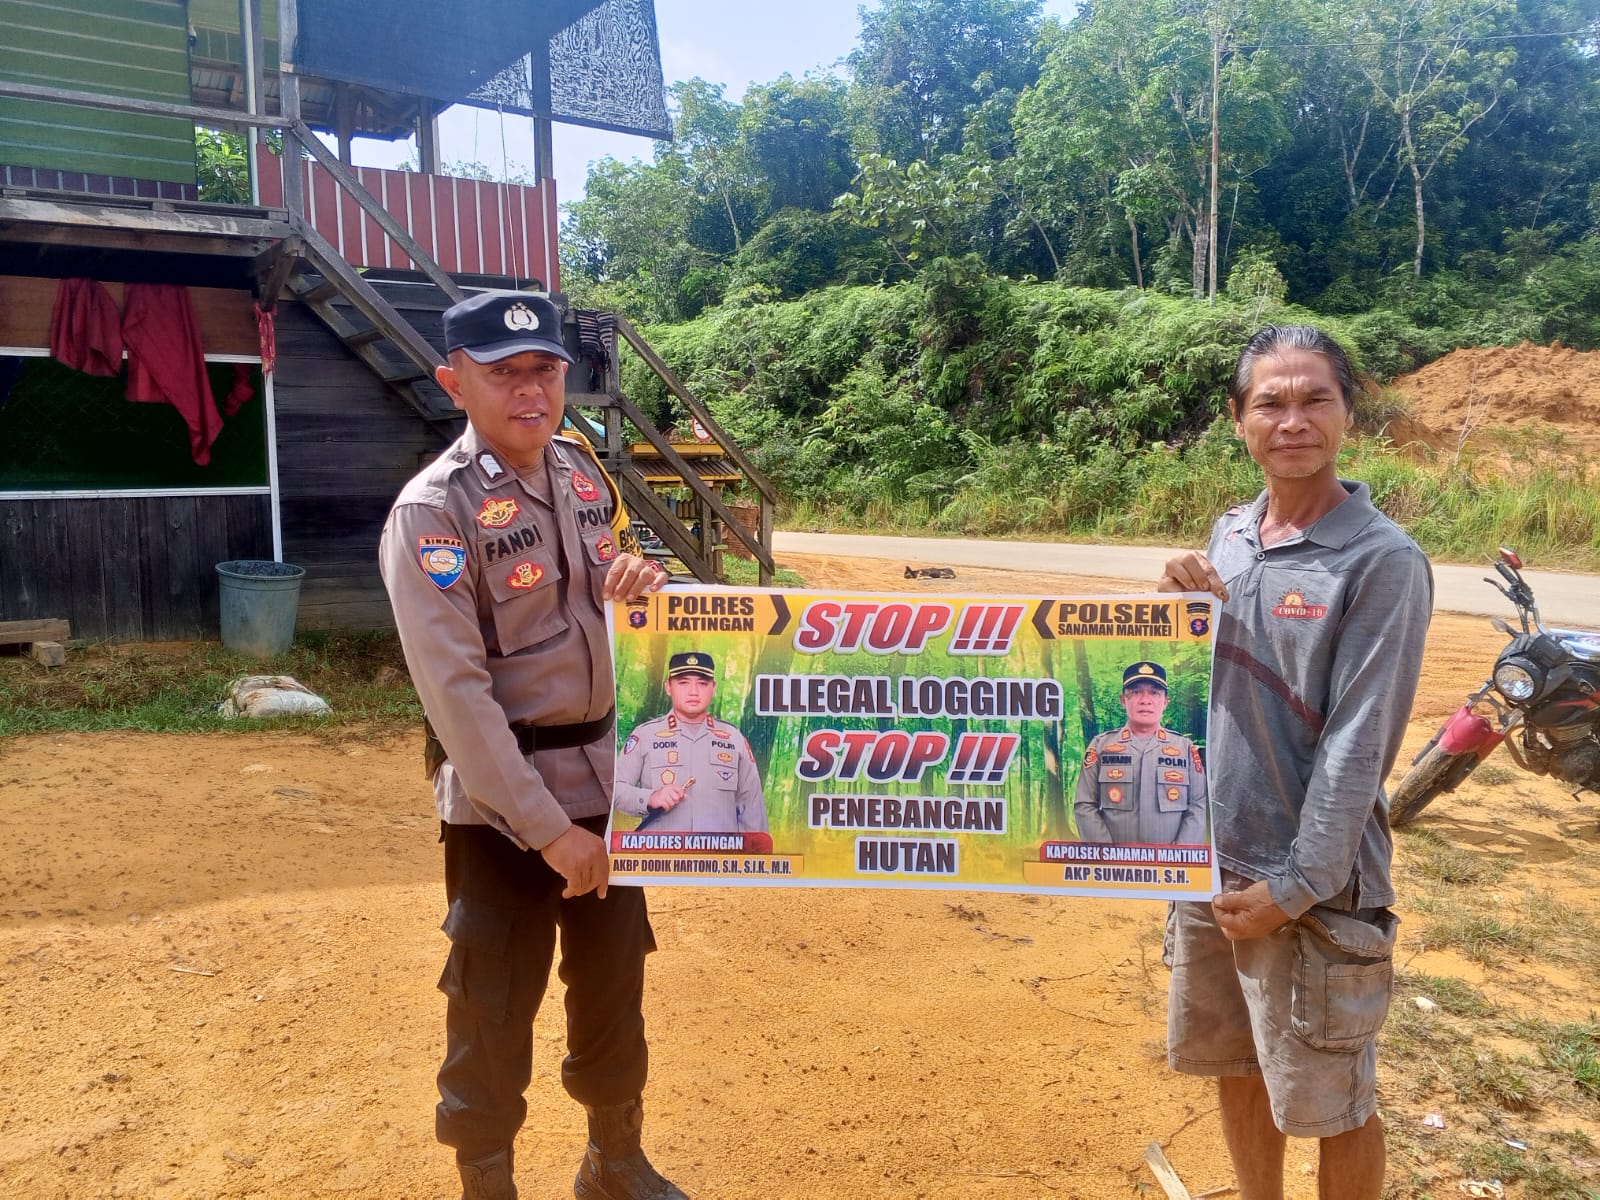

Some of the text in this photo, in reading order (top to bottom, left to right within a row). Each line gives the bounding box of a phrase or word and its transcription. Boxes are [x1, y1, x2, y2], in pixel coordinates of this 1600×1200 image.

[485, 524, 544, 562] FANDI
[668, 595, 754, 616] POLRES
[1058, 603, 1172, 624] POLSEK
[1278, 607, 1323, 617] COVID-19
[668, 616, 754, 632] KATINGAN
[797, 602, 1025, 650] STOP !!!
[1058, 623, 1172, 637] SANAMAN MANTIKEI
[759, 678, 1060, 718] ILLEGAL LOGGING
[653, 741, 678, 750] DODIK
[711, 740, 736, 750] POLRI
[798, 731, 1017, 782] STOP !!!
[1157, 756, 1187, 768] POLRI
[811, 797, 1004, 831] PENEBANGAN
[621, 834, 744, 851] KAPOLRES KATINGAN
[858, 840, 956, 873] HUTAN
[1046, 845, 1209, 863] KAPOLSEK SANAMAN MANTIKEI
[613, 859, 638, 872] AKBP
[641, 859, 671, 873] DODIK
[673, 859, 720, 874] HARTONO,
[771, 862, 792, 875] M.H.
[1064, 866, 1190, 884] AKP SUWARDI, S.H.
